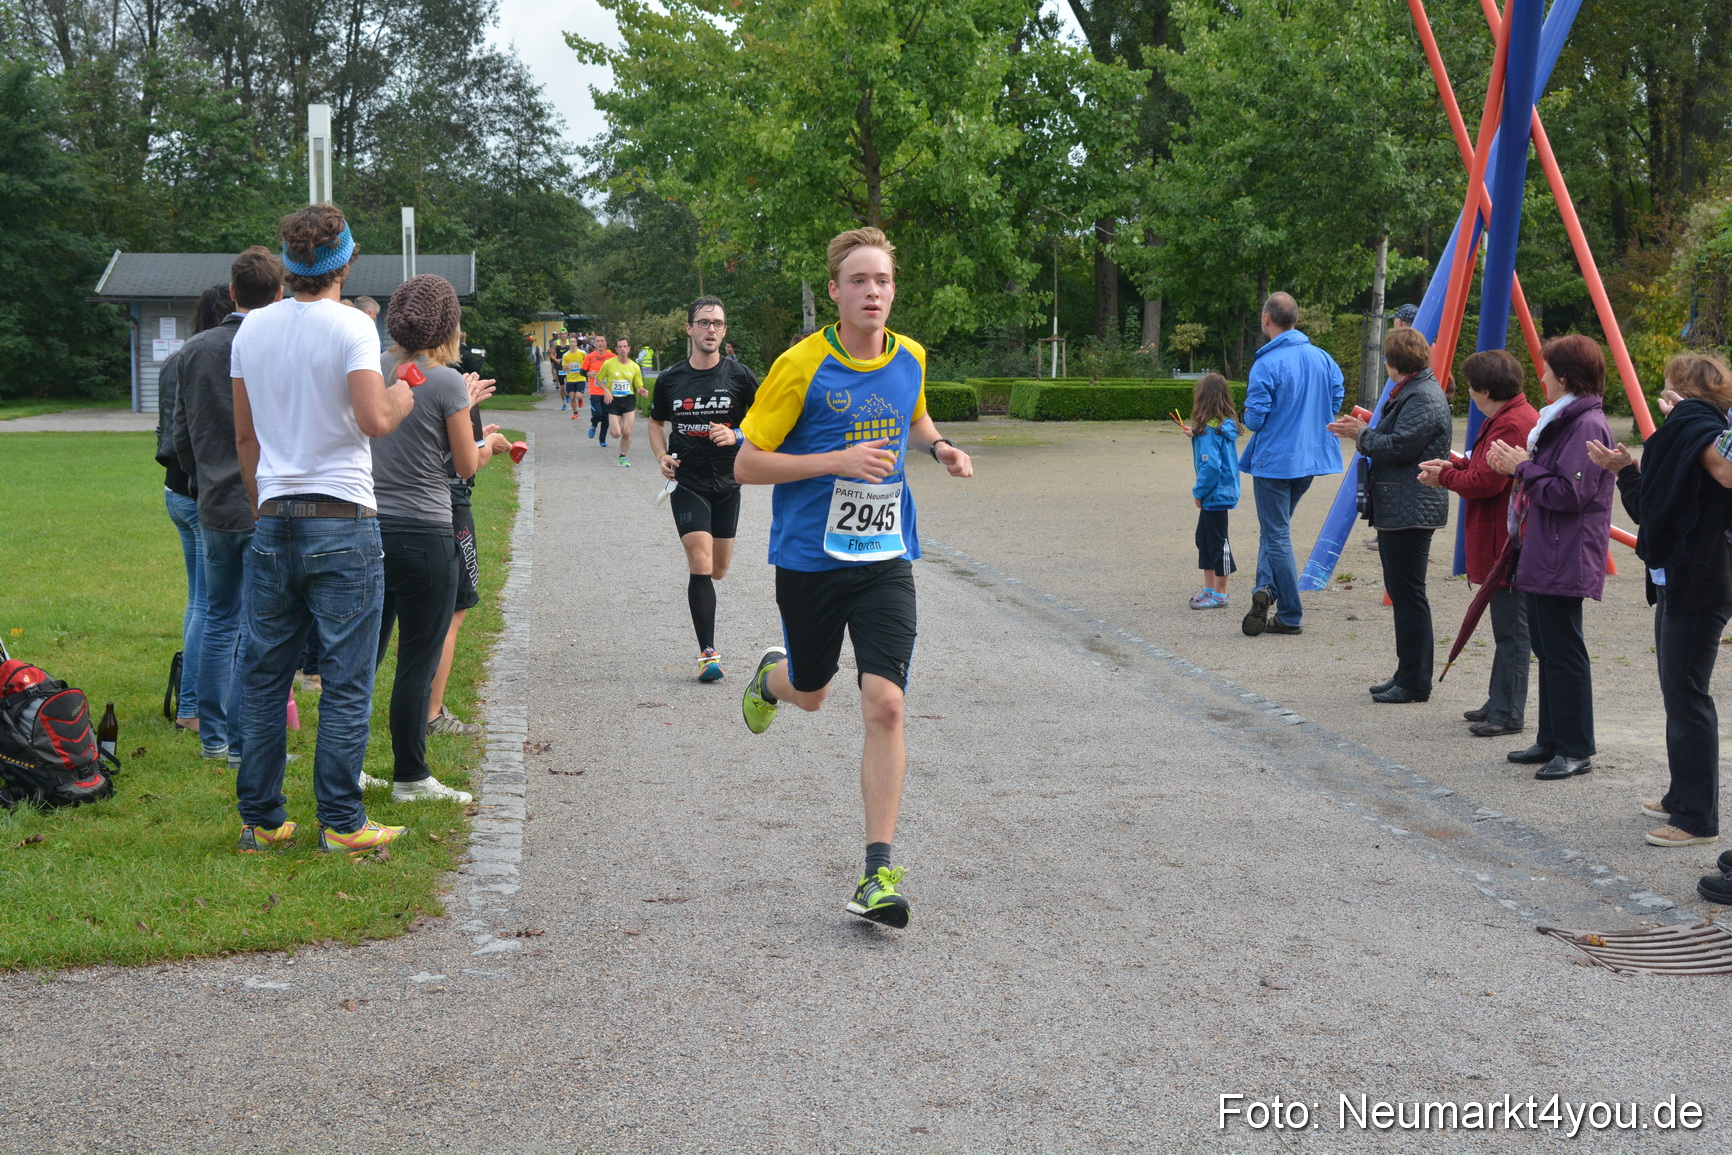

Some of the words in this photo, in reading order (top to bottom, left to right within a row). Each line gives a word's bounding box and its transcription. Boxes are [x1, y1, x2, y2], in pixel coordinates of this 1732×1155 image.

[613, 383, 629, 391] 2317
[672, 396, 732, 411] POLAR
[835, 487, 865, 499] PARTL
[275, 503, 317, 517] PMA
[836, 501, 896, 532] 2945
[848, 538, 882, 551] Florian
